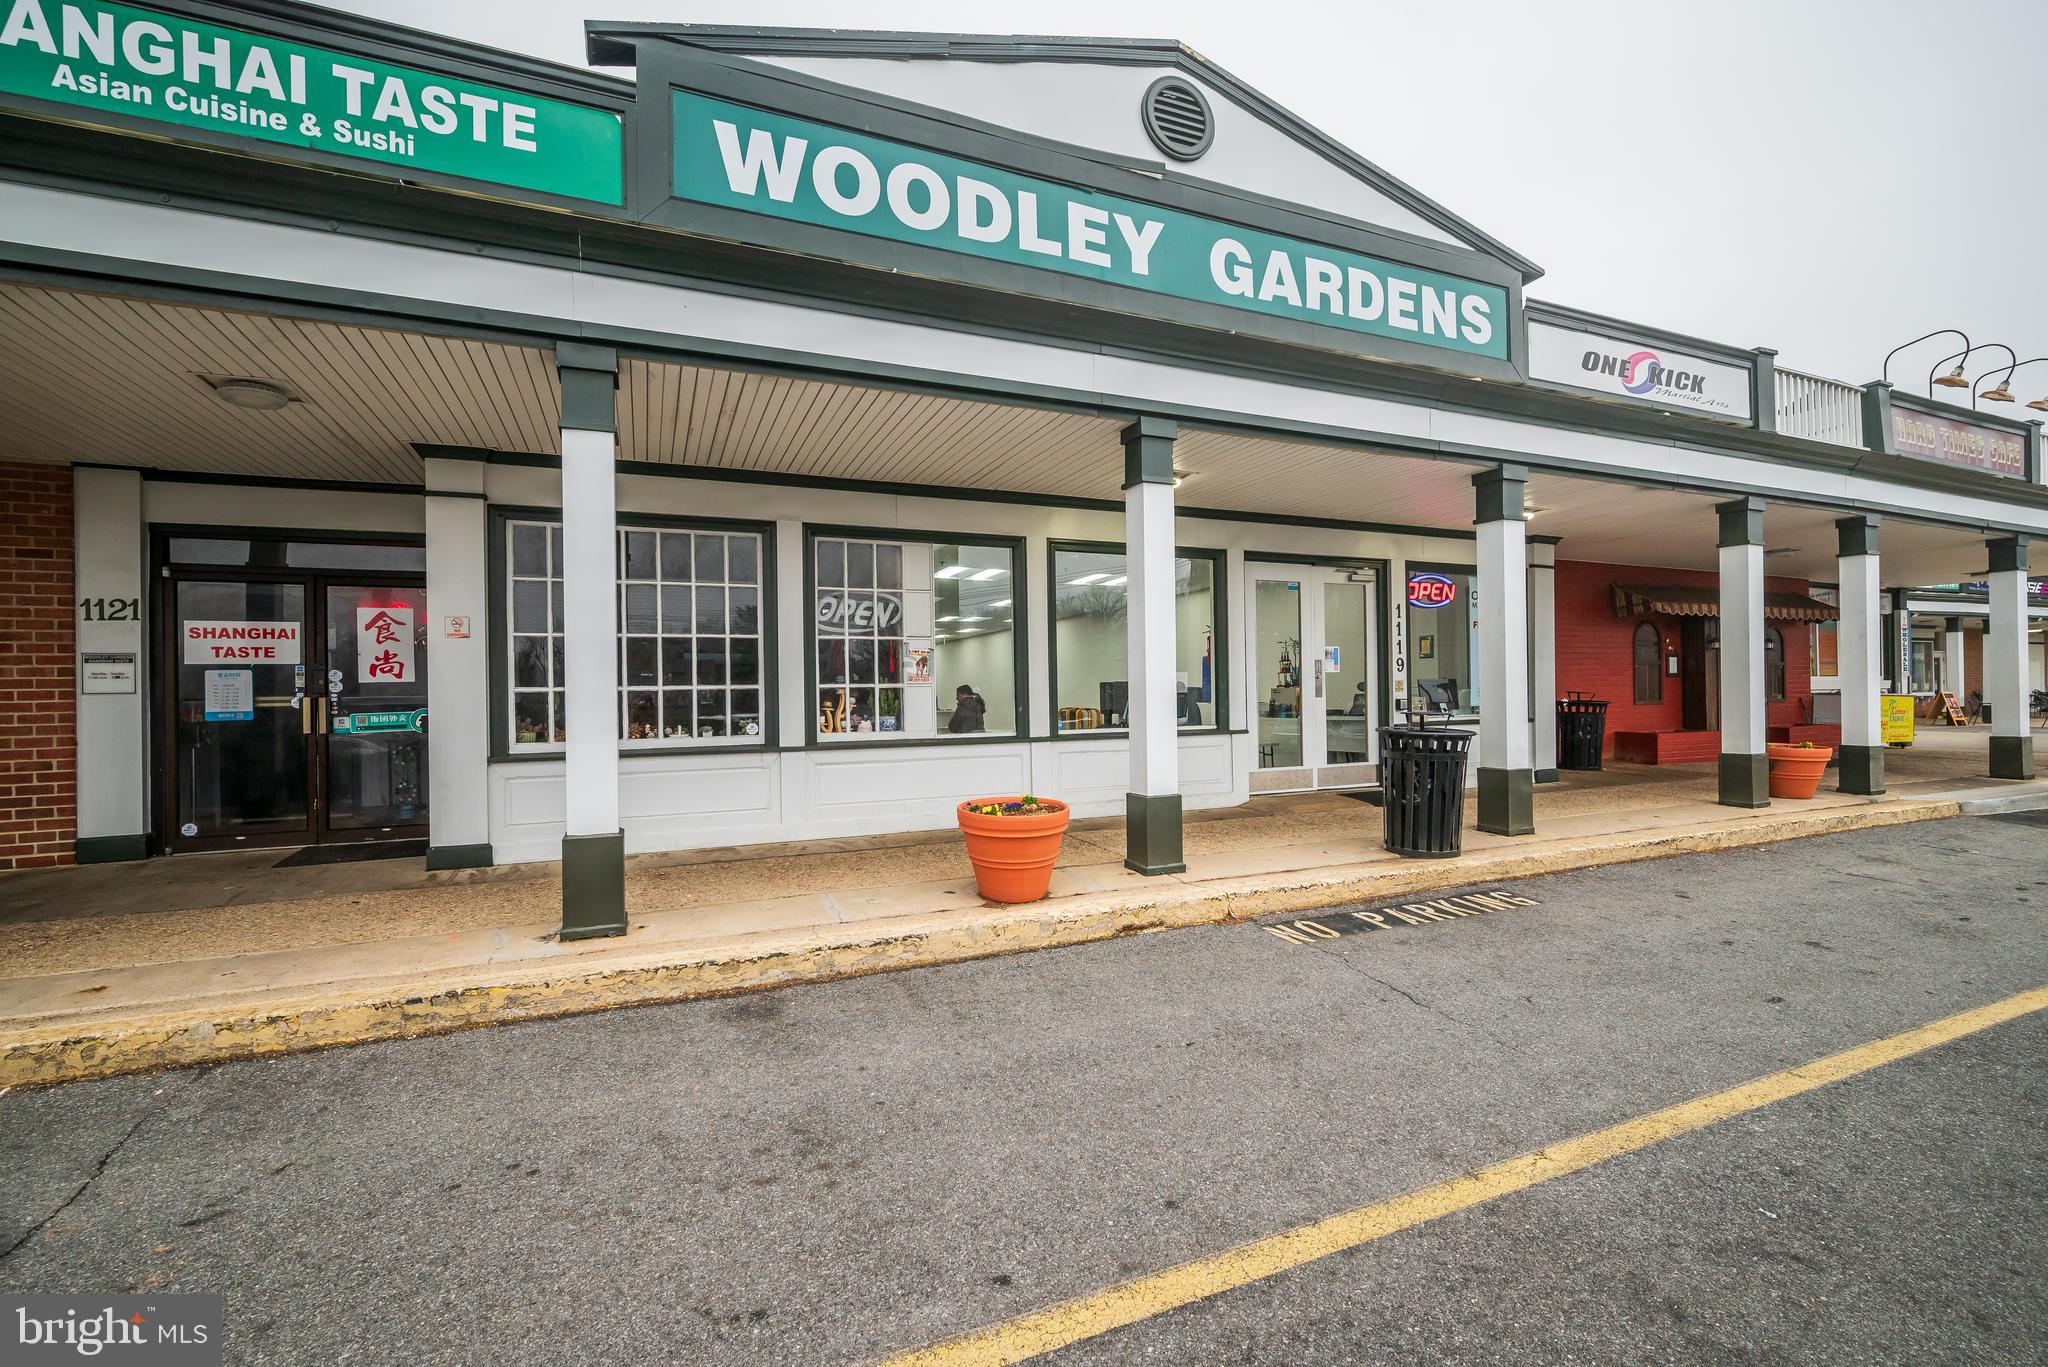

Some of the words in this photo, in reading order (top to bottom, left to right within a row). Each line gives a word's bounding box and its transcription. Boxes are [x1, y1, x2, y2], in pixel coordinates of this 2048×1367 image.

[0, 0, 306, 105] ANGHAI
[332, 63, 537, 153] TASTE
[51, 64, 153, 105] Asian
[165, 86, 288, 131] Cuisine
[299, 112, 322, 138] &
[333, 119, 415, 156] Sushi
[712, 119, 1165, 276] WOODLEY
[1210, 238, 1492, 345] GARDENS
[1581, 351, 1632, 379] ONE
[1648, 365, 1706, 394] KICK
[1655, 386, 1702, 402] Martial
[1701, 398, 1729, 409] Arts
[1894, 416, 1936, 449] HARD
[1939, 427, 1985, 459] TIMES
[80, 598, 141, 621] 1121
[818, 596, 896, 629] OPEN
[188, 626, 297, 640] SHANGHAI
[211, 646, 276, 659] TASTE
[1395, 603, 1405, 673] 1119
[1262, 919, 1342, 945] NO
[1350, 890, 1542, 930] PARKING
